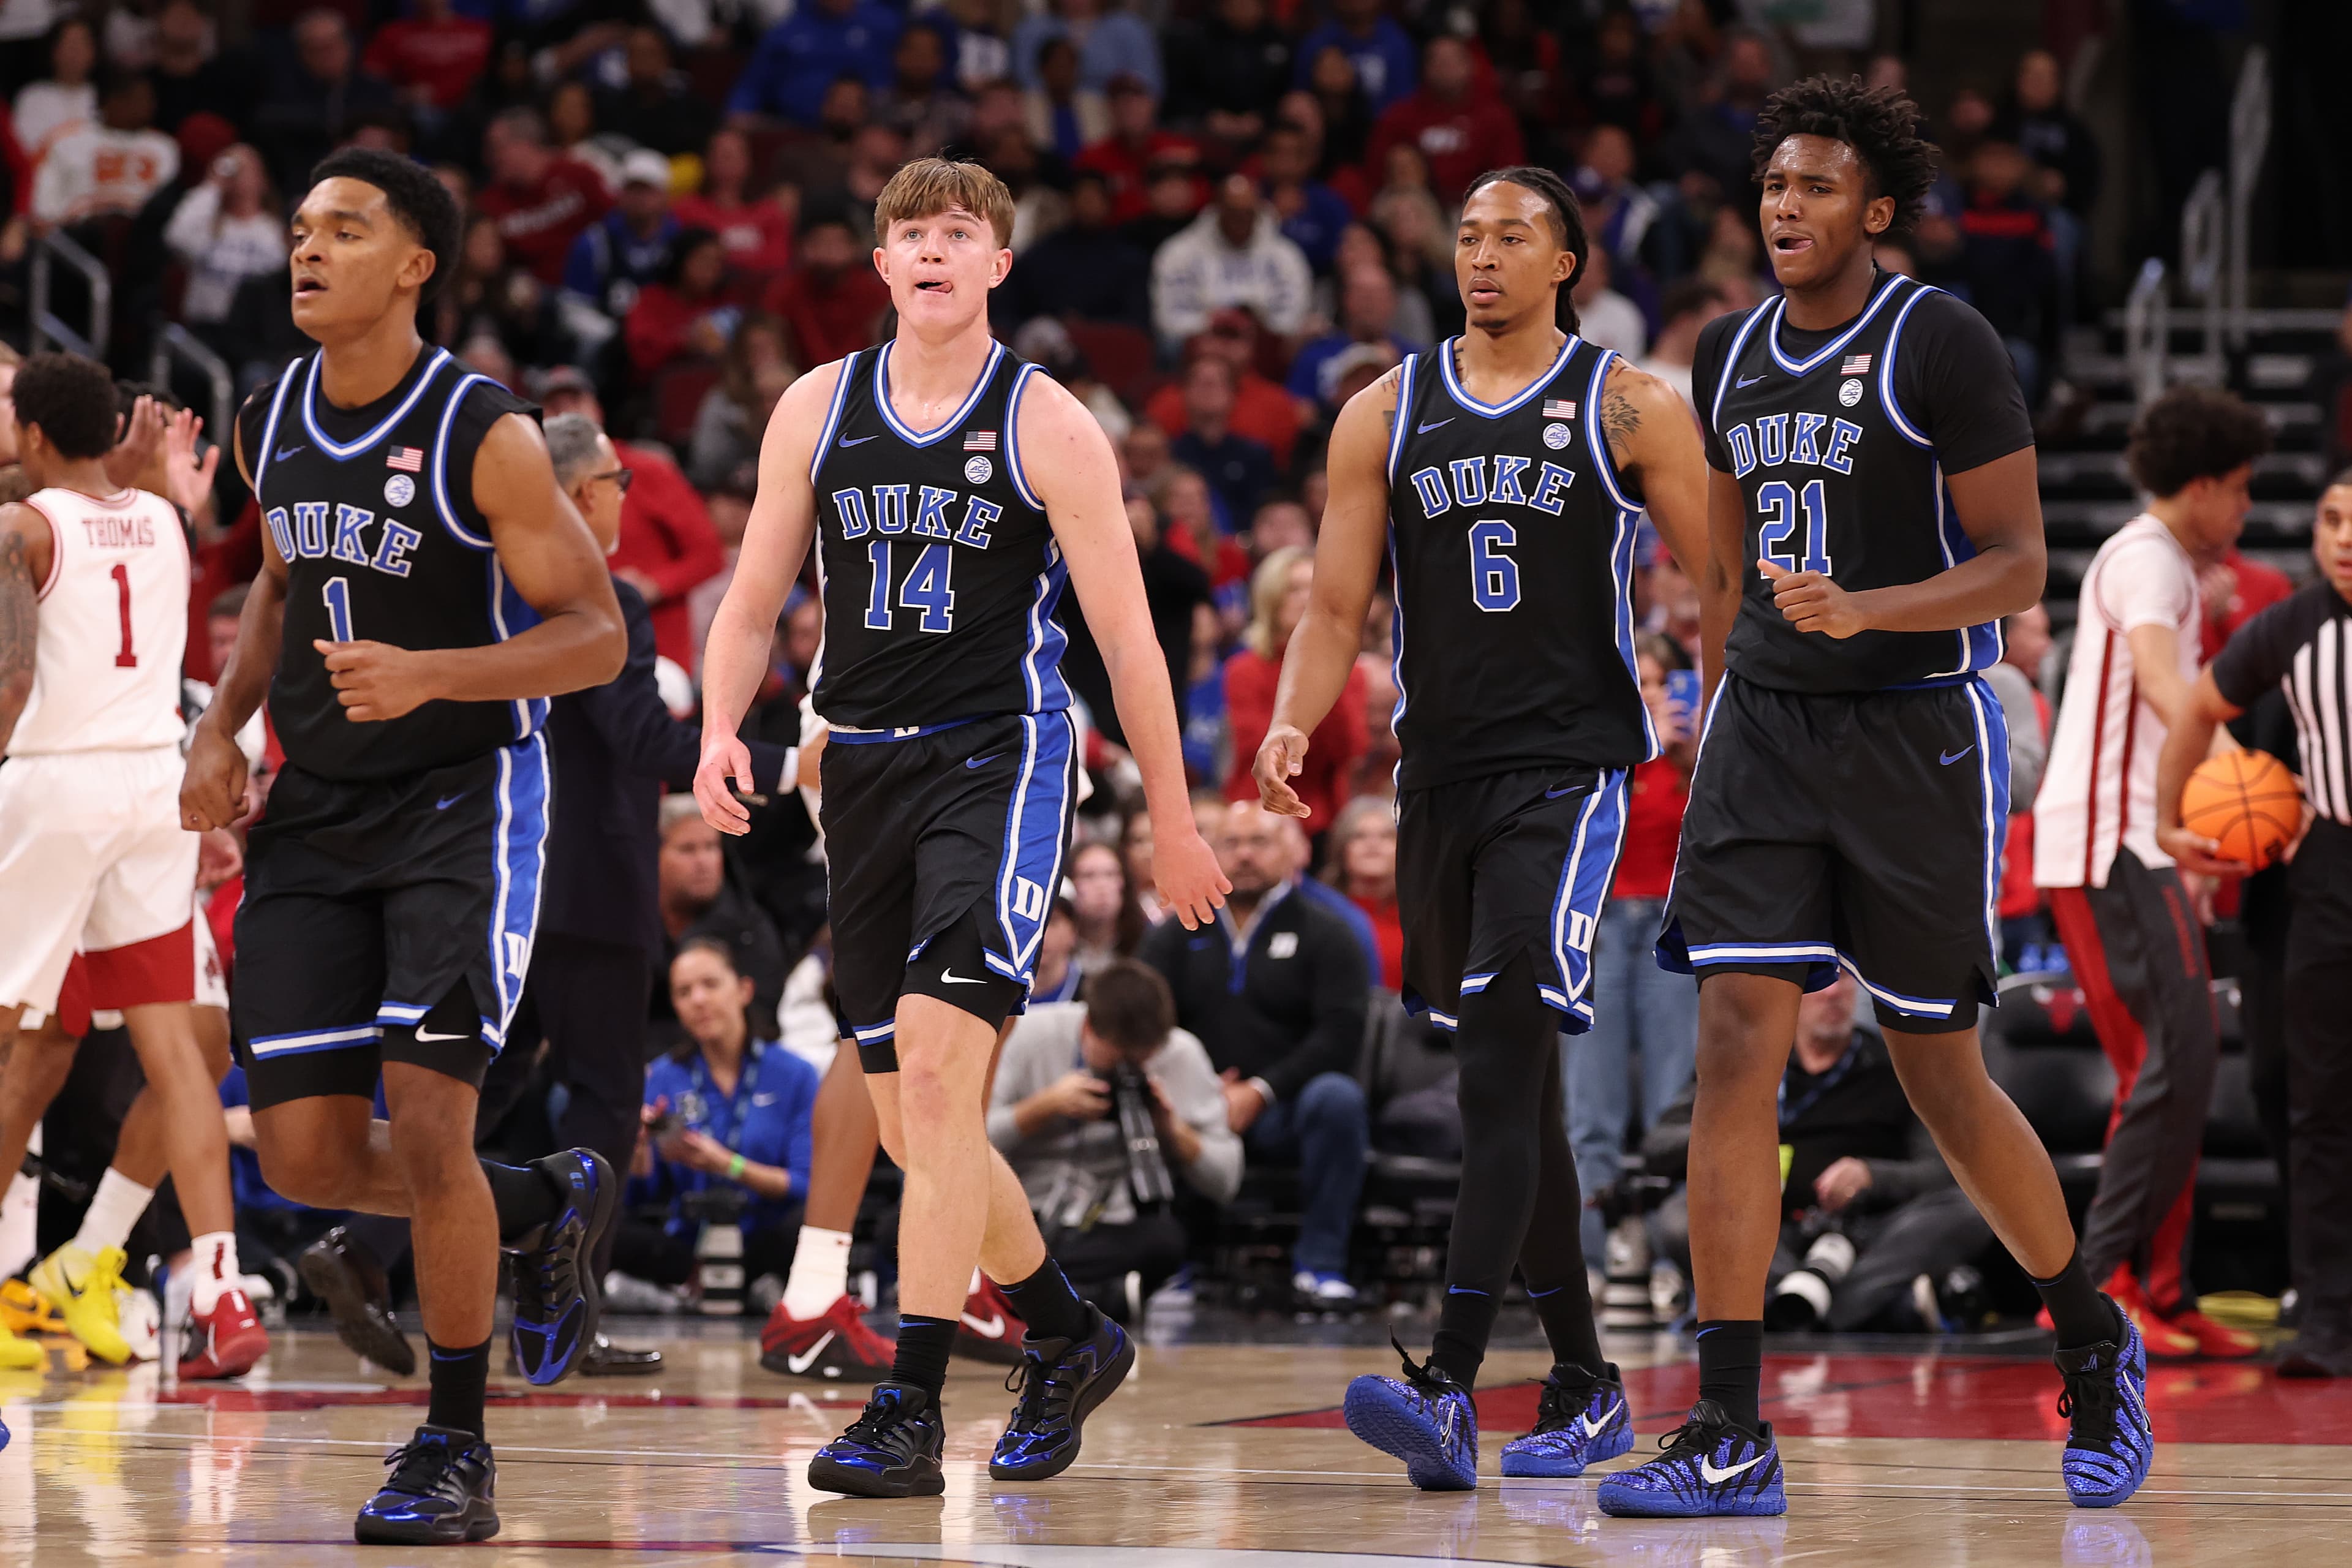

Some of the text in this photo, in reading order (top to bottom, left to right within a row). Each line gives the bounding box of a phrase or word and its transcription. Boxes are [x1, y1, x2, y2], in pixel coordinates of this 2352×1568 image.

[1726, 412, 1863, 480] DUKE
[832, 484, 1003, 549] DUKE
[1410, 454, 1576, 519] DUKE
[81, 516, 155, 548] THOMAS
[266, 502, 423, 578] DUKE
[1757, 480, 1832, 579] 21
[864, 540, 955, 633] 14
[1468, 519, 1521, 612] 6
[111, 564, 137, 667] 1
[322, 576, 354, 643] 1
[1011, 875, 1044, 922] D
